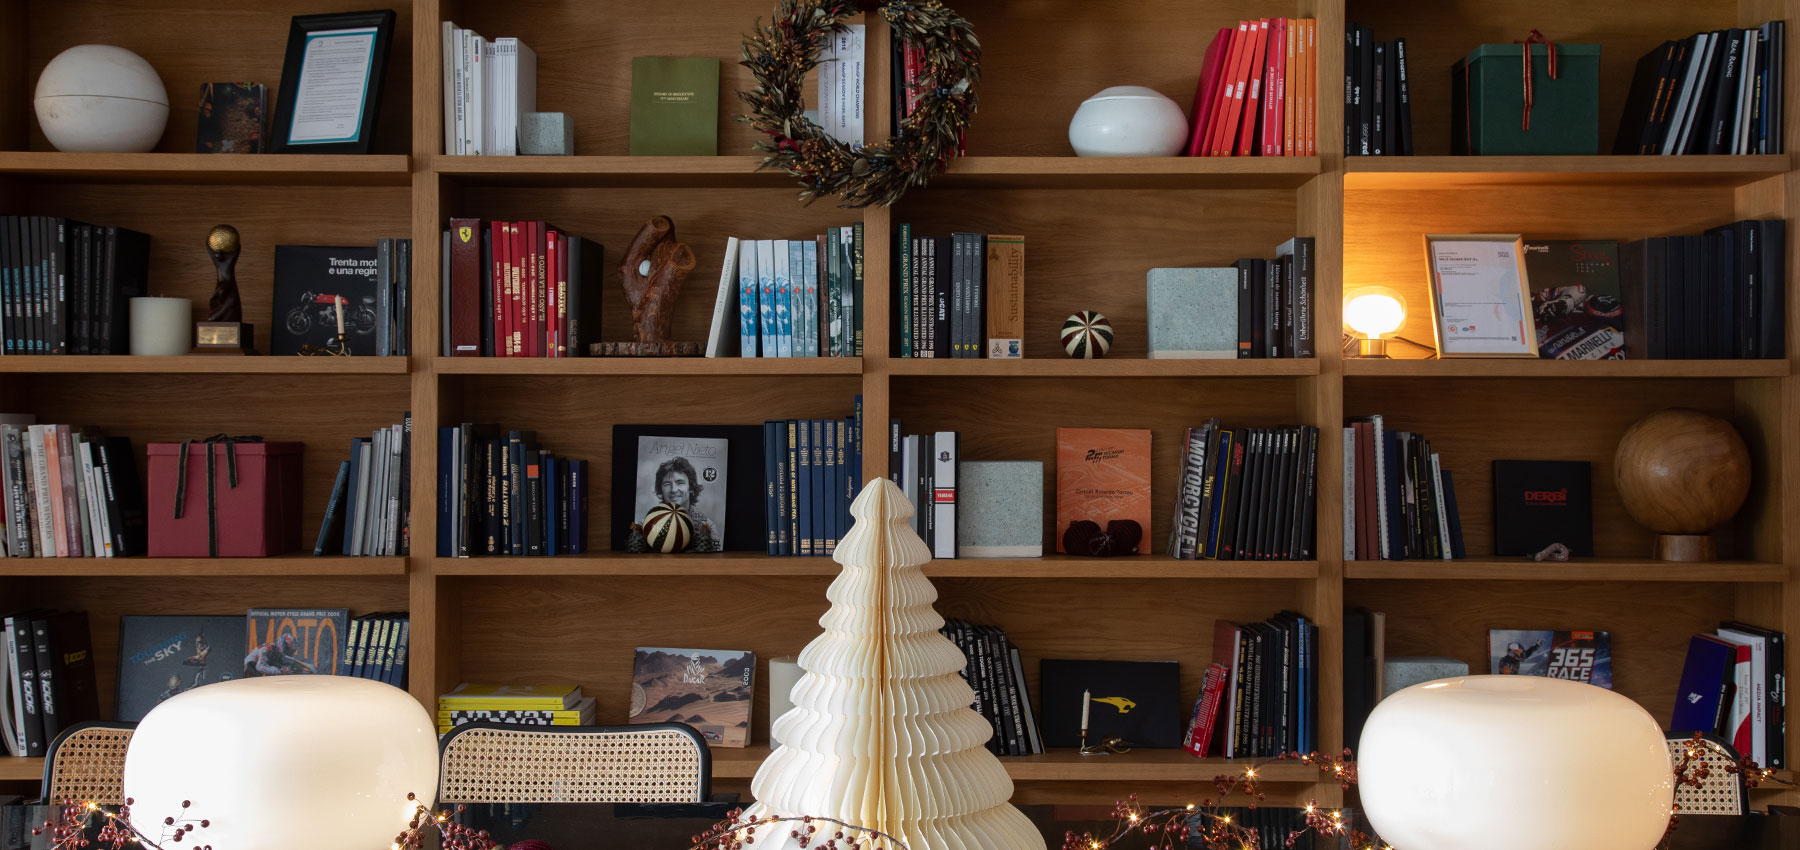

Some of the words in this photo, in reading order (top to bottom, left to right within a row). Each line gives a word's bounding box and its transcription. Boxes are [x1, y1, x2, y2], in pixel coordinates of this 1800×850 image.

[1730, 39, 1739, 55] REAL
[1726, 56, 1737, 78] RACING
[329, 257, 358, 267] Trenta
[360, 258, 378, 267] mot
[355, 267, 378, 277] regin
[1008, 248, 1020, 322] Sustainability
[1299, 276, 1307, 306] Schönheit
[1299, 306, 1307, 340] Unberührte
[1567, 330, 1613, 361] MARINELLI
[37, 444, 45, 459] THE
[685, 443, 717, 457] Nieto
[39, 460, 48, 486] GRAND
[41, 487, 49, 504] PRIX
[1181, 438, 1206, 546] MOTORCYCLE
[43, 504, 53, 540] WINNERS
[129, 631, 188, 664] TOUCHING
[144, 657, 156, 666] THE
[154, 640, 182, 662] SKY
[249, 617, 338, 675] MOTO
[1549, 648, 1596, 667] 365
[683, 673, 706, 685] DAKAR
[742, 667, 750, 686] 2003
[1246, 662, 1254, 681] GRAND
[1546, 667, 1592, 680] RACE
[1244, 696, 1252, 733] ILLUSTRATED
